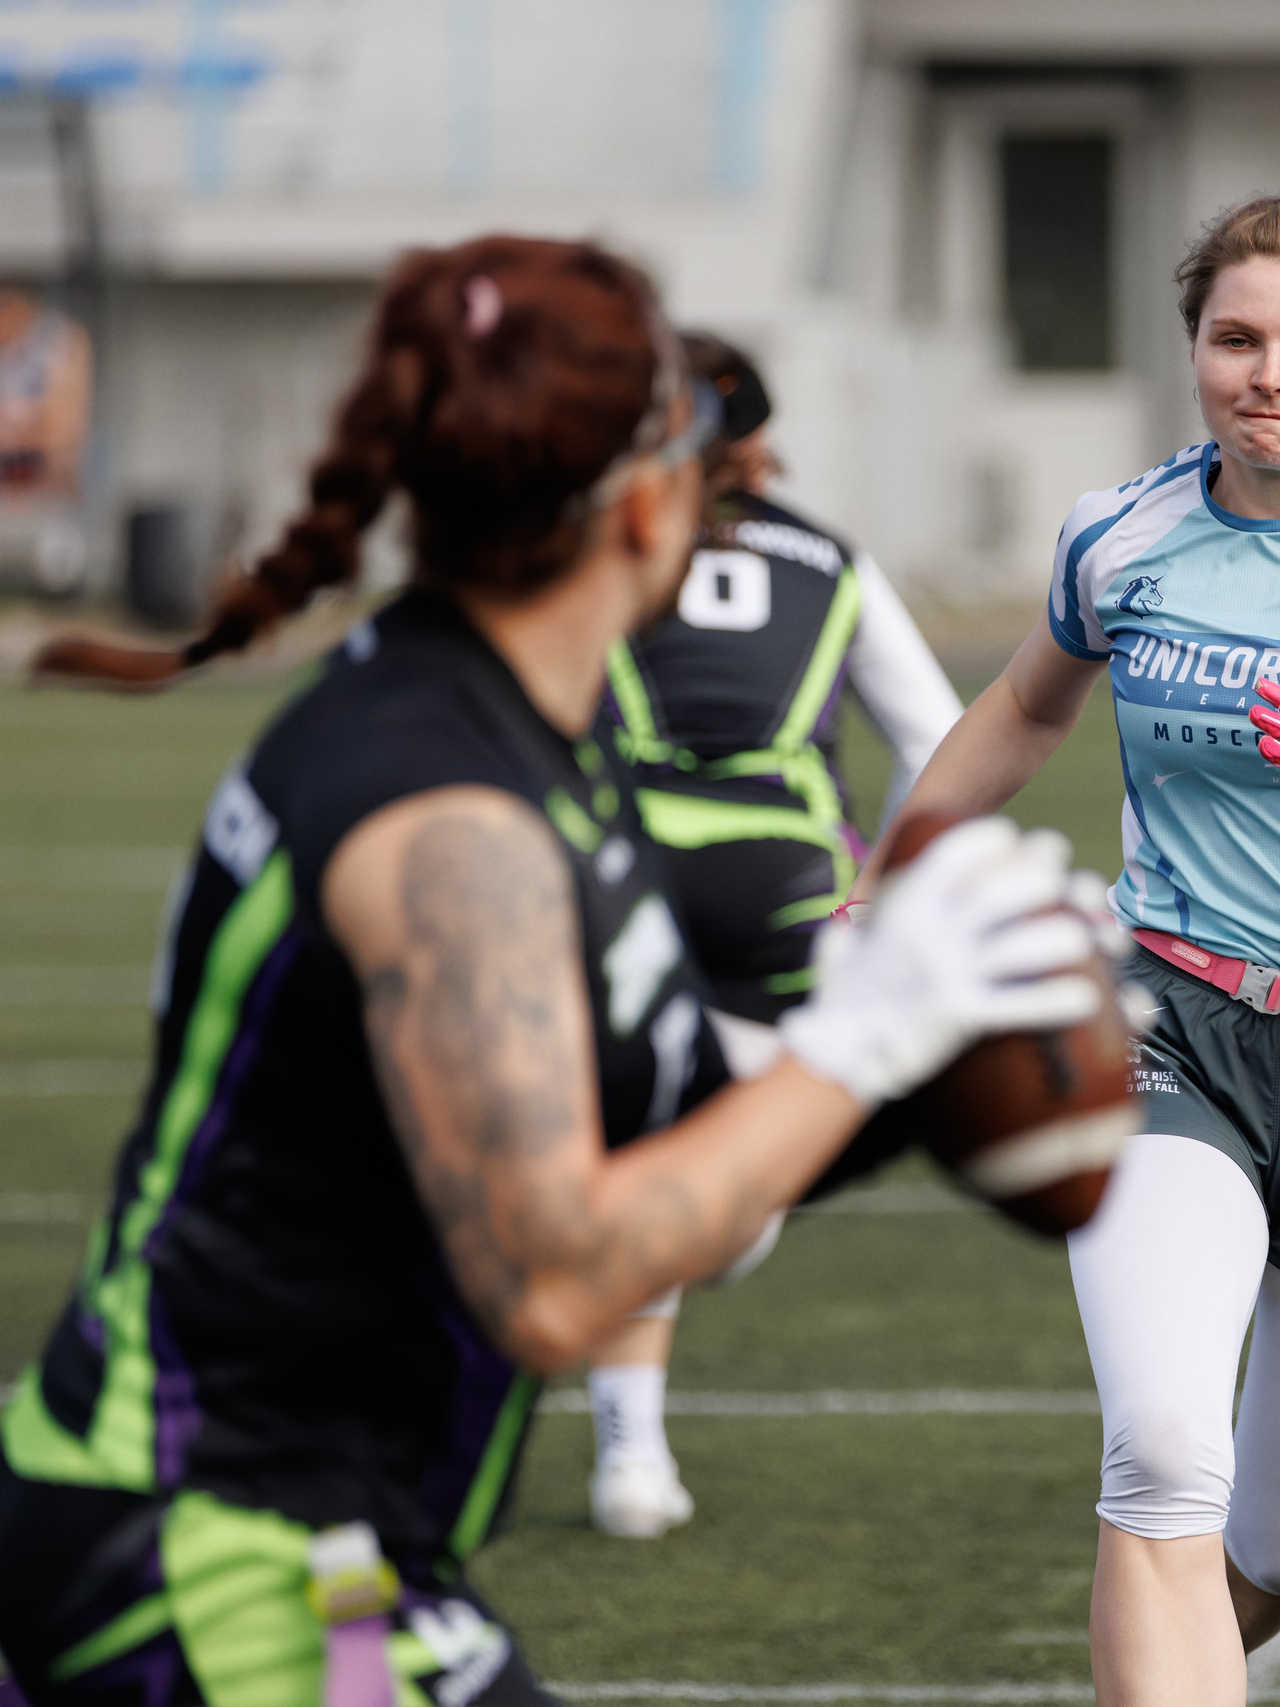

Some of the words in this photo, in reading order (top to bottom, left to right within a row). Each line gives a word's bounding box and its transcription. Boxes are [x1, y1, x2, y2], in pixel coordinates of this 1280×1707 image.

[1165, 689, 1246, 709] TEA
[1154, 721, 1266, 748] MOSC
[1132, 1069, 1149, 1080] WE
[1152, 1071, 1178, 1083] RISE,
[1136, 1081, 1152, 1092] WE
[1155, 1083, 1180, 1094] FALL
